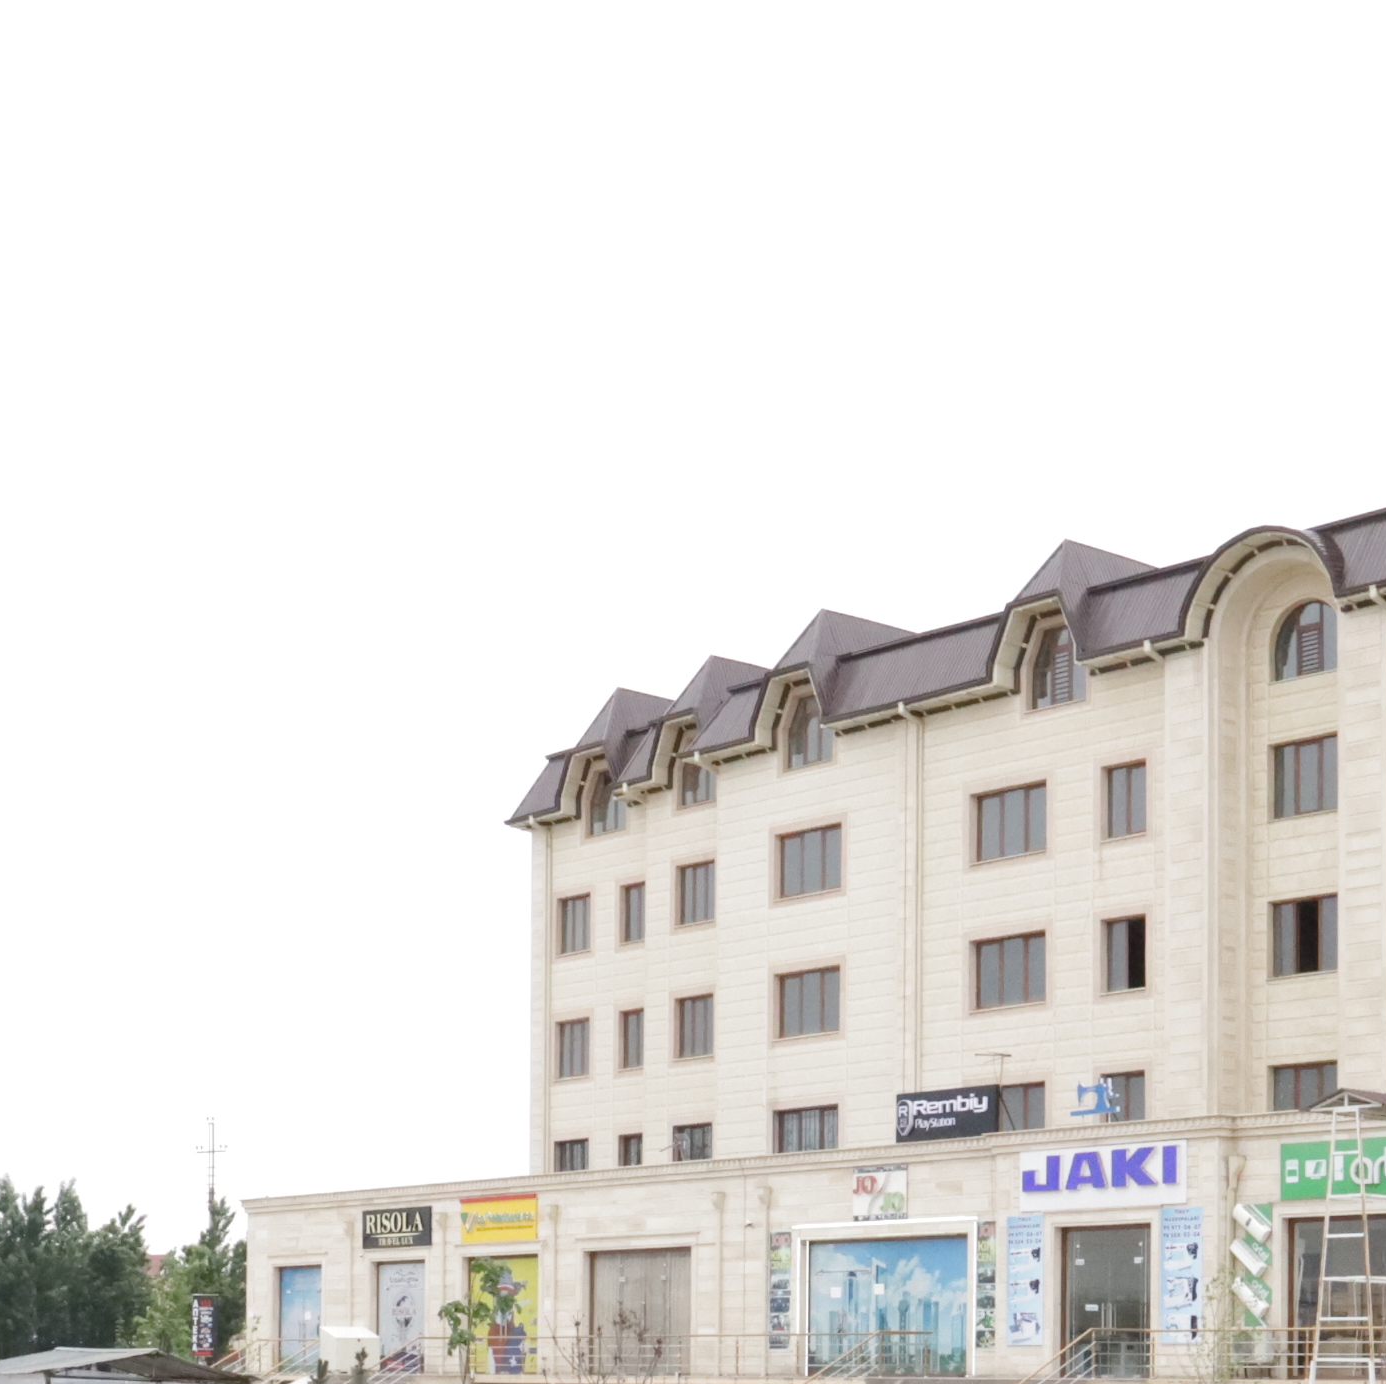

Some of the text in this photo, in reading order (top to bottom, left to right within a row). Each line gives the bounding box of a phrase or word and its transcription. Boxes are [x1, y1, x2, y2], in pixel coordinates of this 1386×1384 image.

[913, 1093, 988, 1115] Rembiy
[915, 1117, 956, 1131] PlayStation
[1022, 1145, 1178, 1192] JAKI
[365, 1211, 424, 1234] RISOLA
